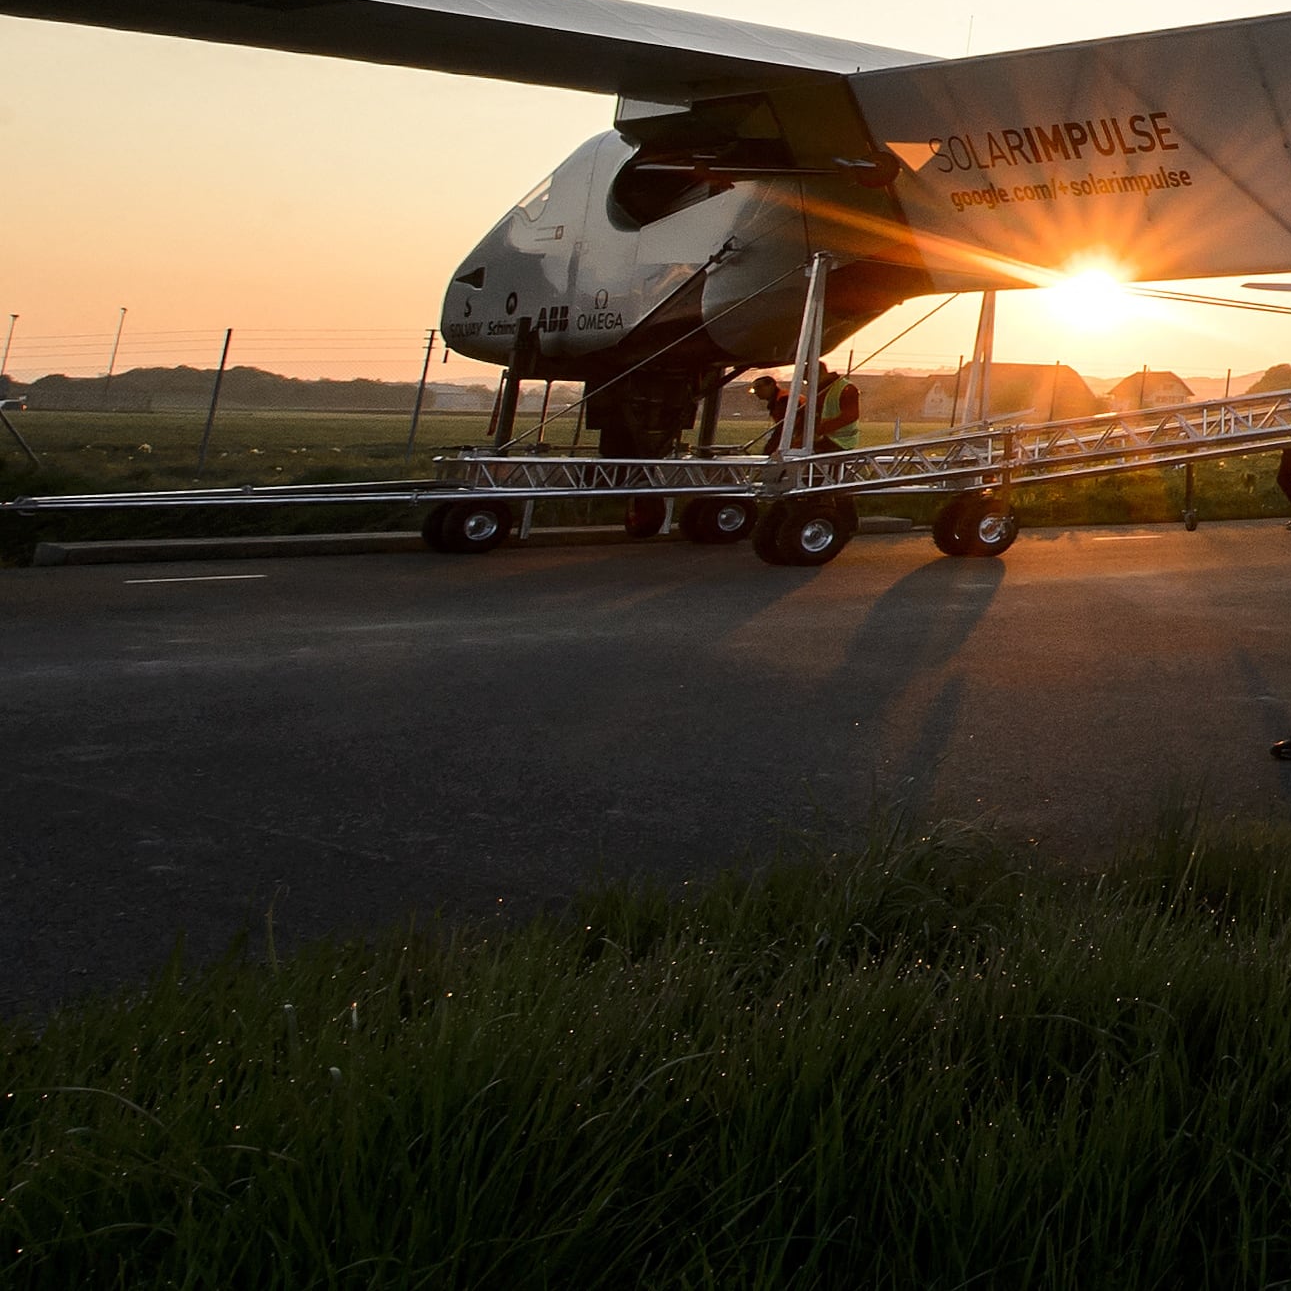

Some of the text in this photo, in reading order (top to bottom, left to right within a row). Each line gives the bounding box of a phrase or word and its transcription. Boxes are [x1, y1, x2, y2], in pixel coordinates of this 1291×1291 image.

[928, 112, 1179, 173] SOLARIMPULSE
[951, 166, 1193, 213] google.com/+solarimpulse
[535, 306, 569, 333] ABB
[577, 312, 624, 332] OMEGA
